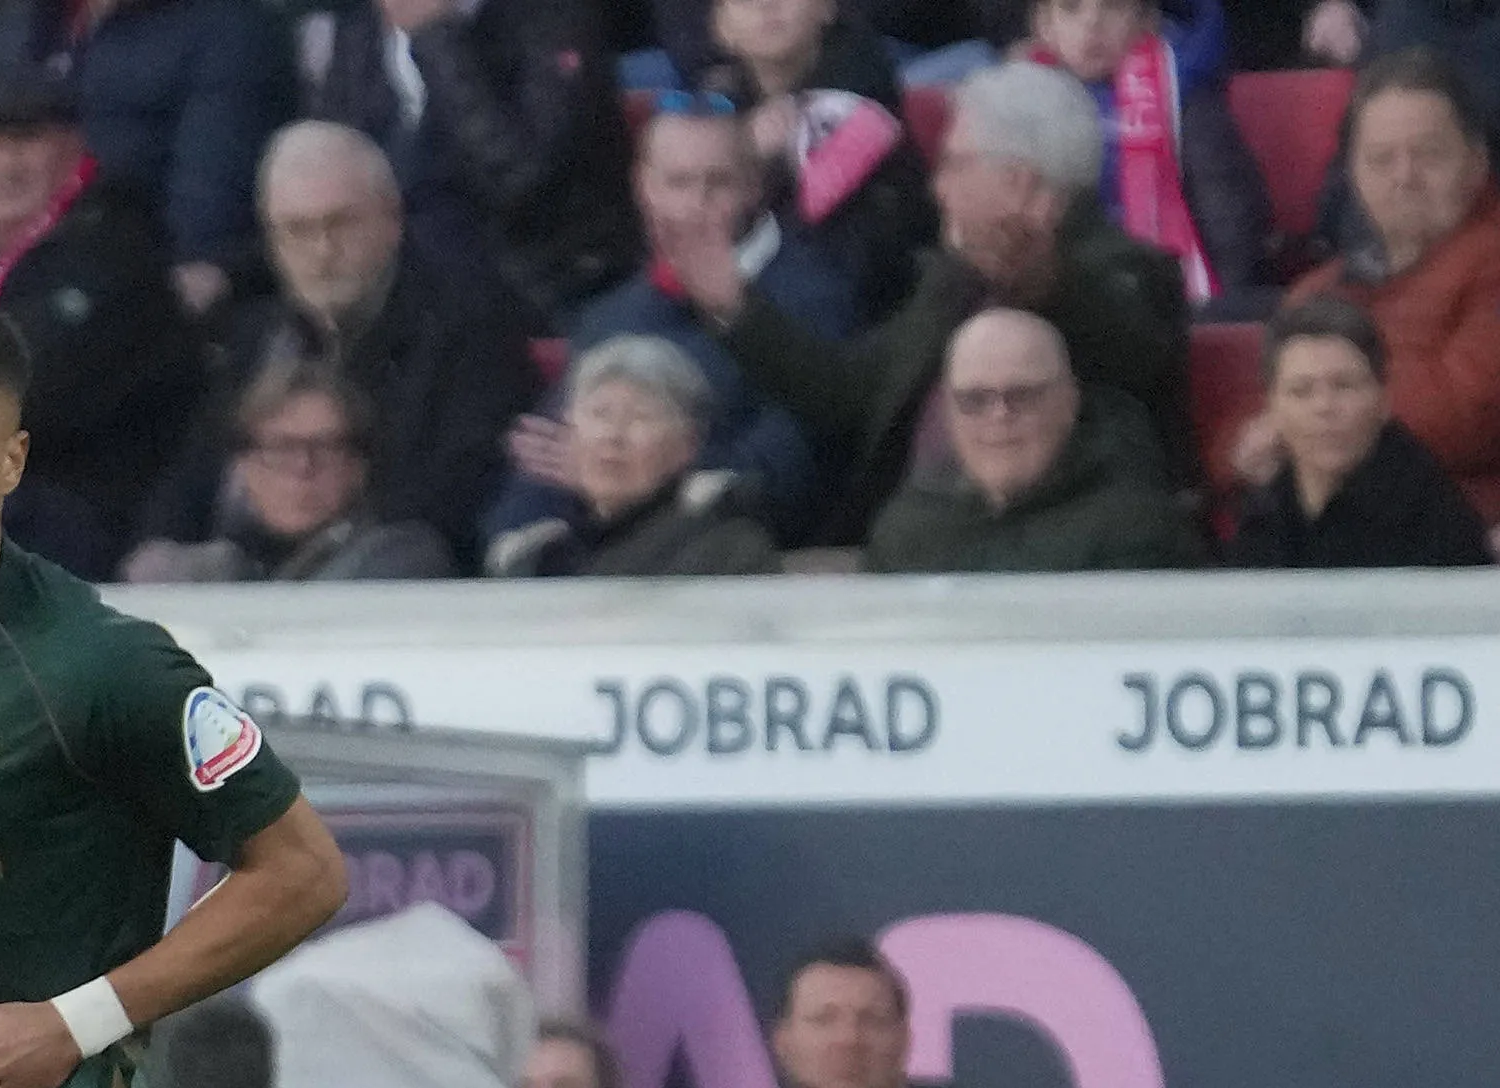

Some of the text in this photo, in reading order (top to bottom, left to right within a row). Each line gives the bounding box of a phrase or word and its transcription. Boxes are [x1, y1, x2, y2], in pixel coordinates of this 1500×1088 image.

[242, 668, 1478, 756] RAD JOBRAD JOBRAD
